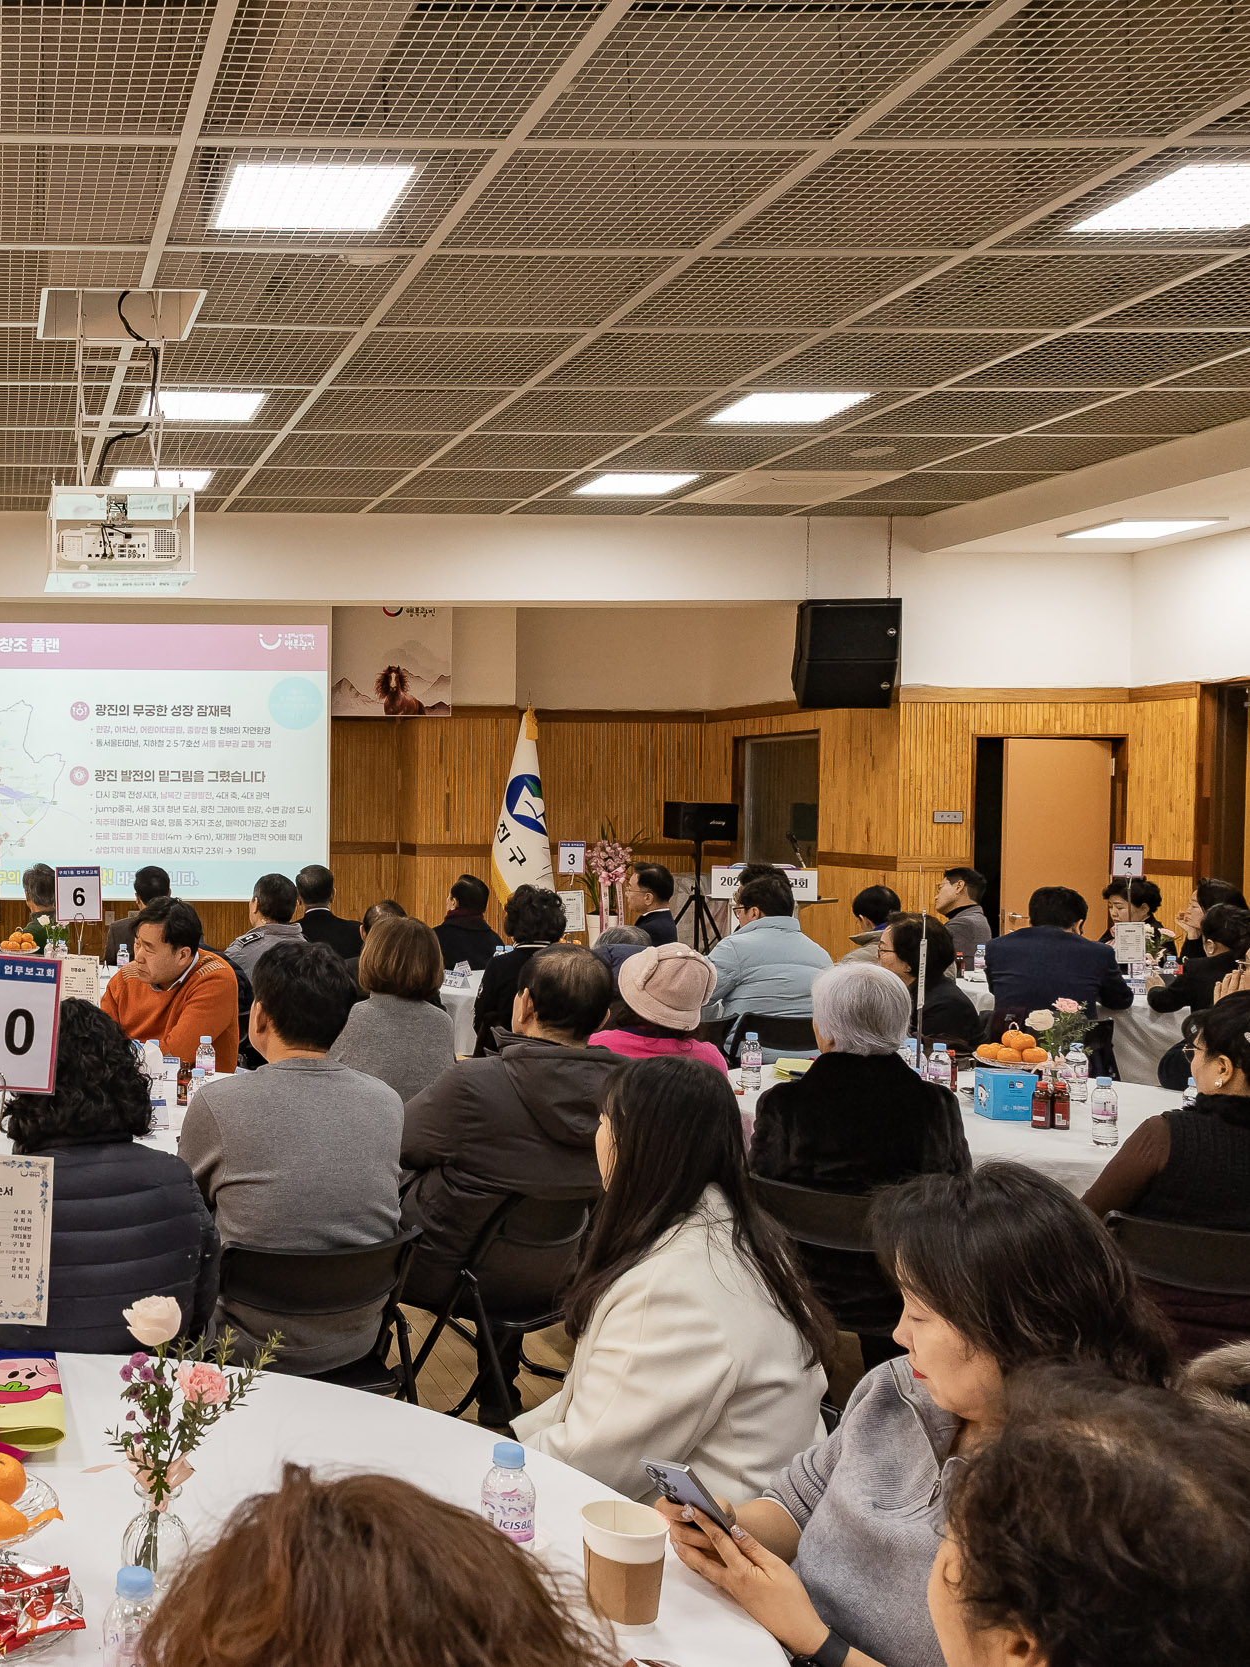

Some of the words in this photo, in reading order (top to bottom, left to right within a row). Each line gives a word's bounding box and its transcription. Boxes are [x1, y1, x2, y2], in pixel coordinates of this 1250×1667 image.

[31, 638, 60, 654] 플랜
[95, 704, 130, 717] 광진의
[133, 705, 168, 717] 무궁한
[171, 705, 194, 718] 성장
[197, 705, 231, 718] 잠재력
[95, 770, 117, 782] 광진
[121, 770, 155, 782] 발전의
[159, 770, 204, 782] 밑그림을
[207, 771, 265, 783] 그렸습니다
[96, 791, 110, 799] 다시
[297, 806, 311, 814] 도시
[568, 854, 576, 865] 3
[1124, 857, 1132, 868] 4
[73, 888, 85, 906] 6
[4, 965, 55, 977] 업무보고회
